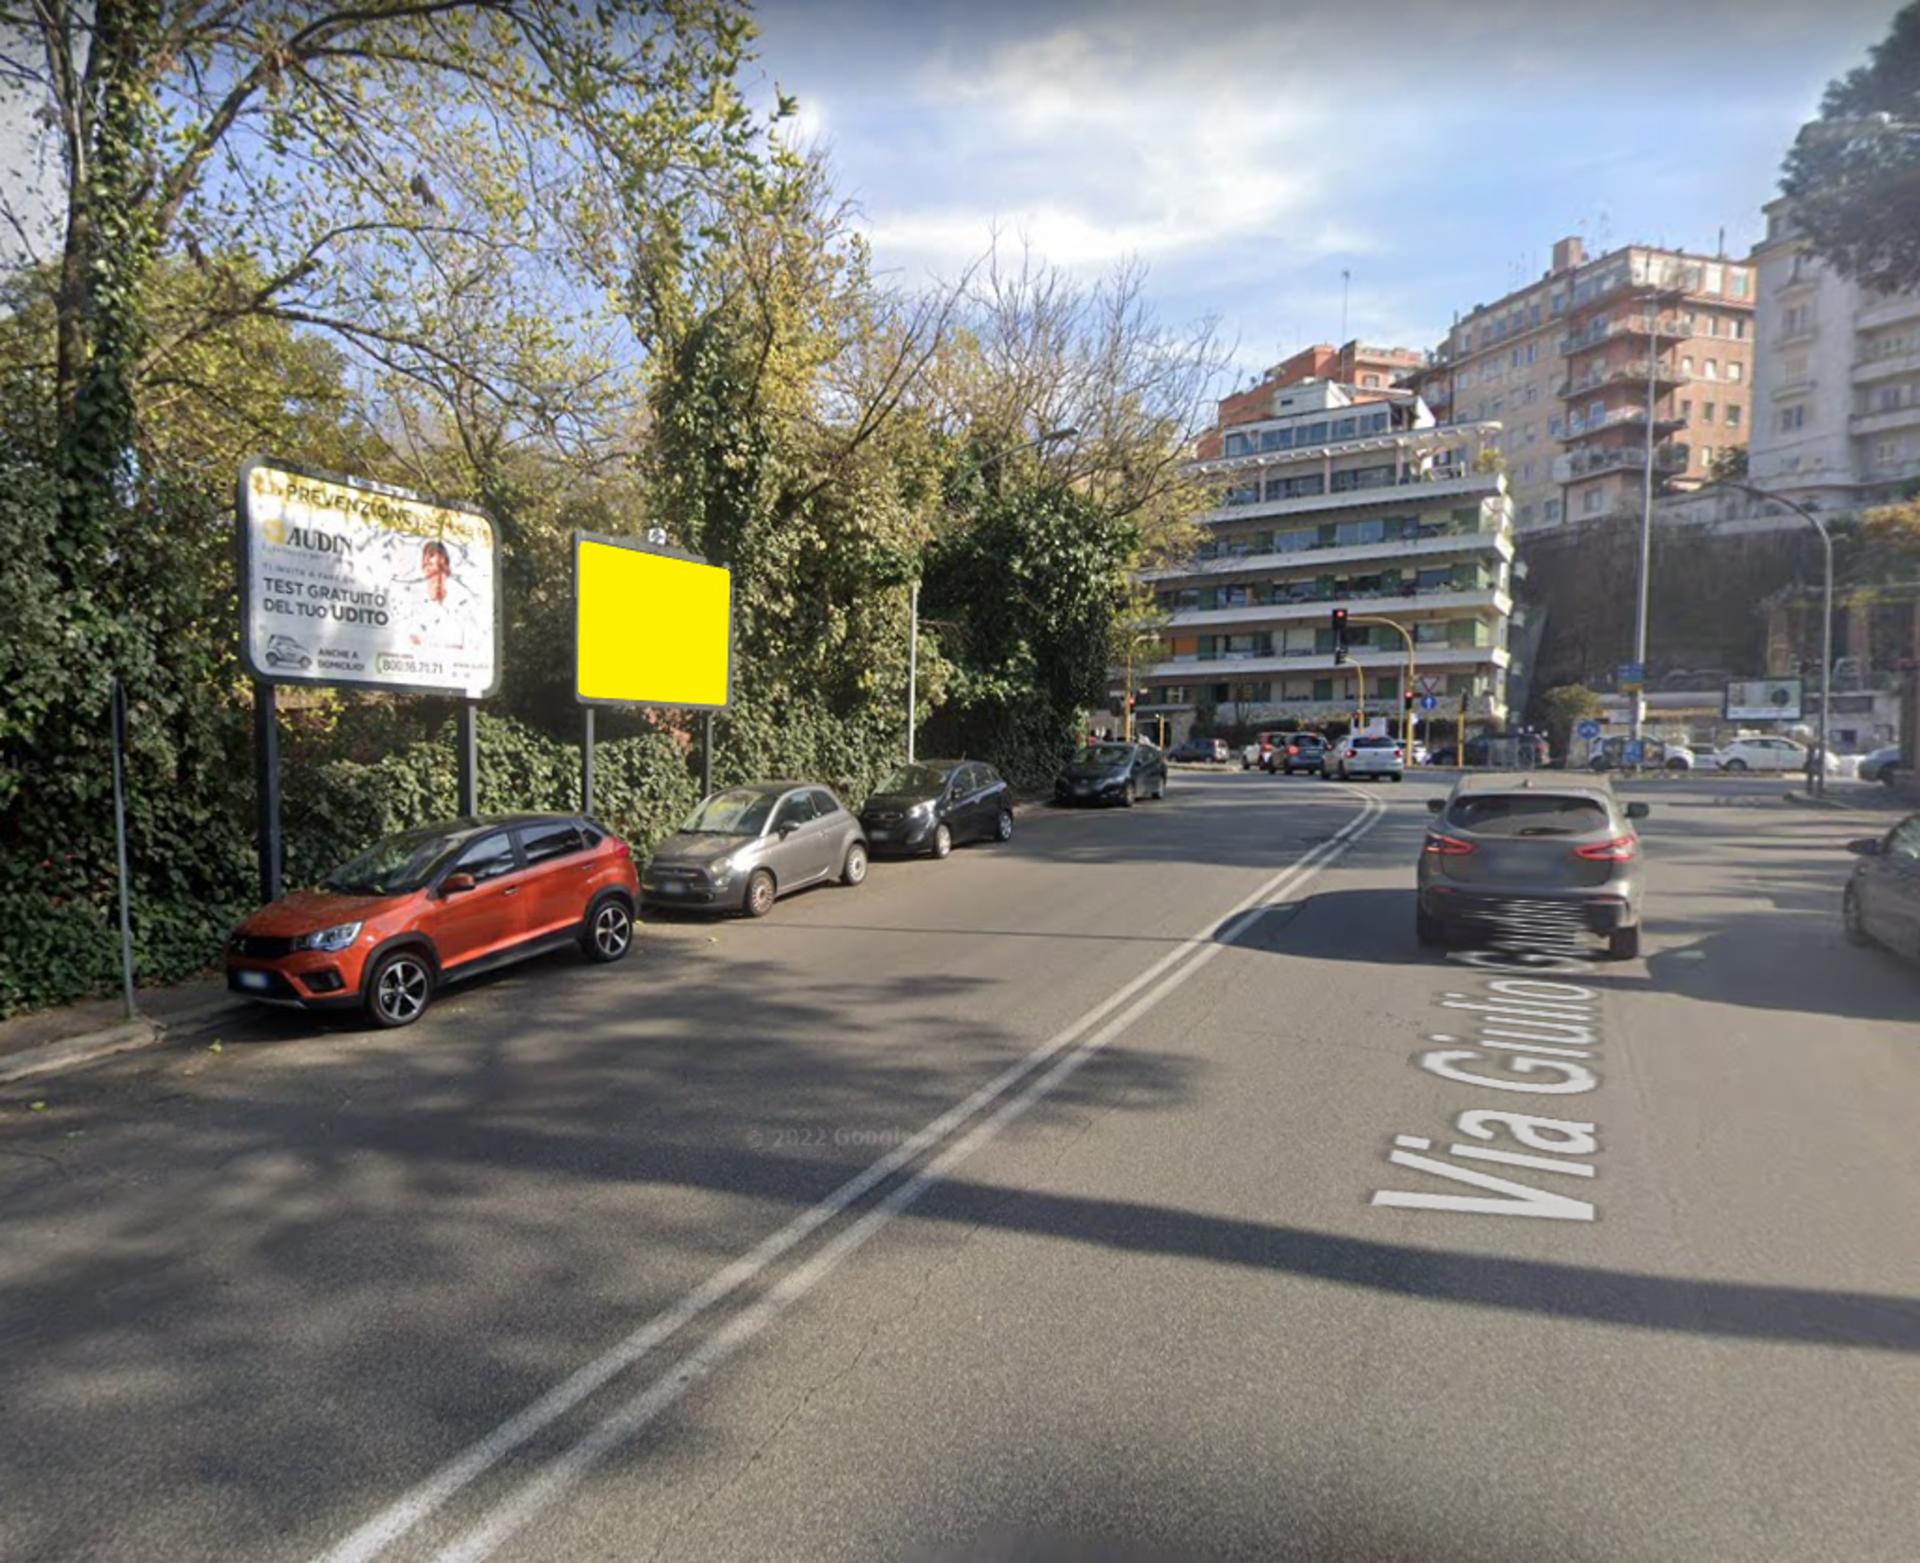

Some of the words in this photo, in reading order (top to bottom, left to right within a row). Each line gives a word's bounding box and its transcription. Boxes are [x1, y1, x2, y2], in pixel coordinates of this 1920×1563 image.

[264, 578, 304, 596] TEST
[308, 582, 387, 608] GRATUITO
[264, 598, 297, 613] DEL
[298, 602, 327, 619] TUO
[332, 605, 389, 626] UDITO
